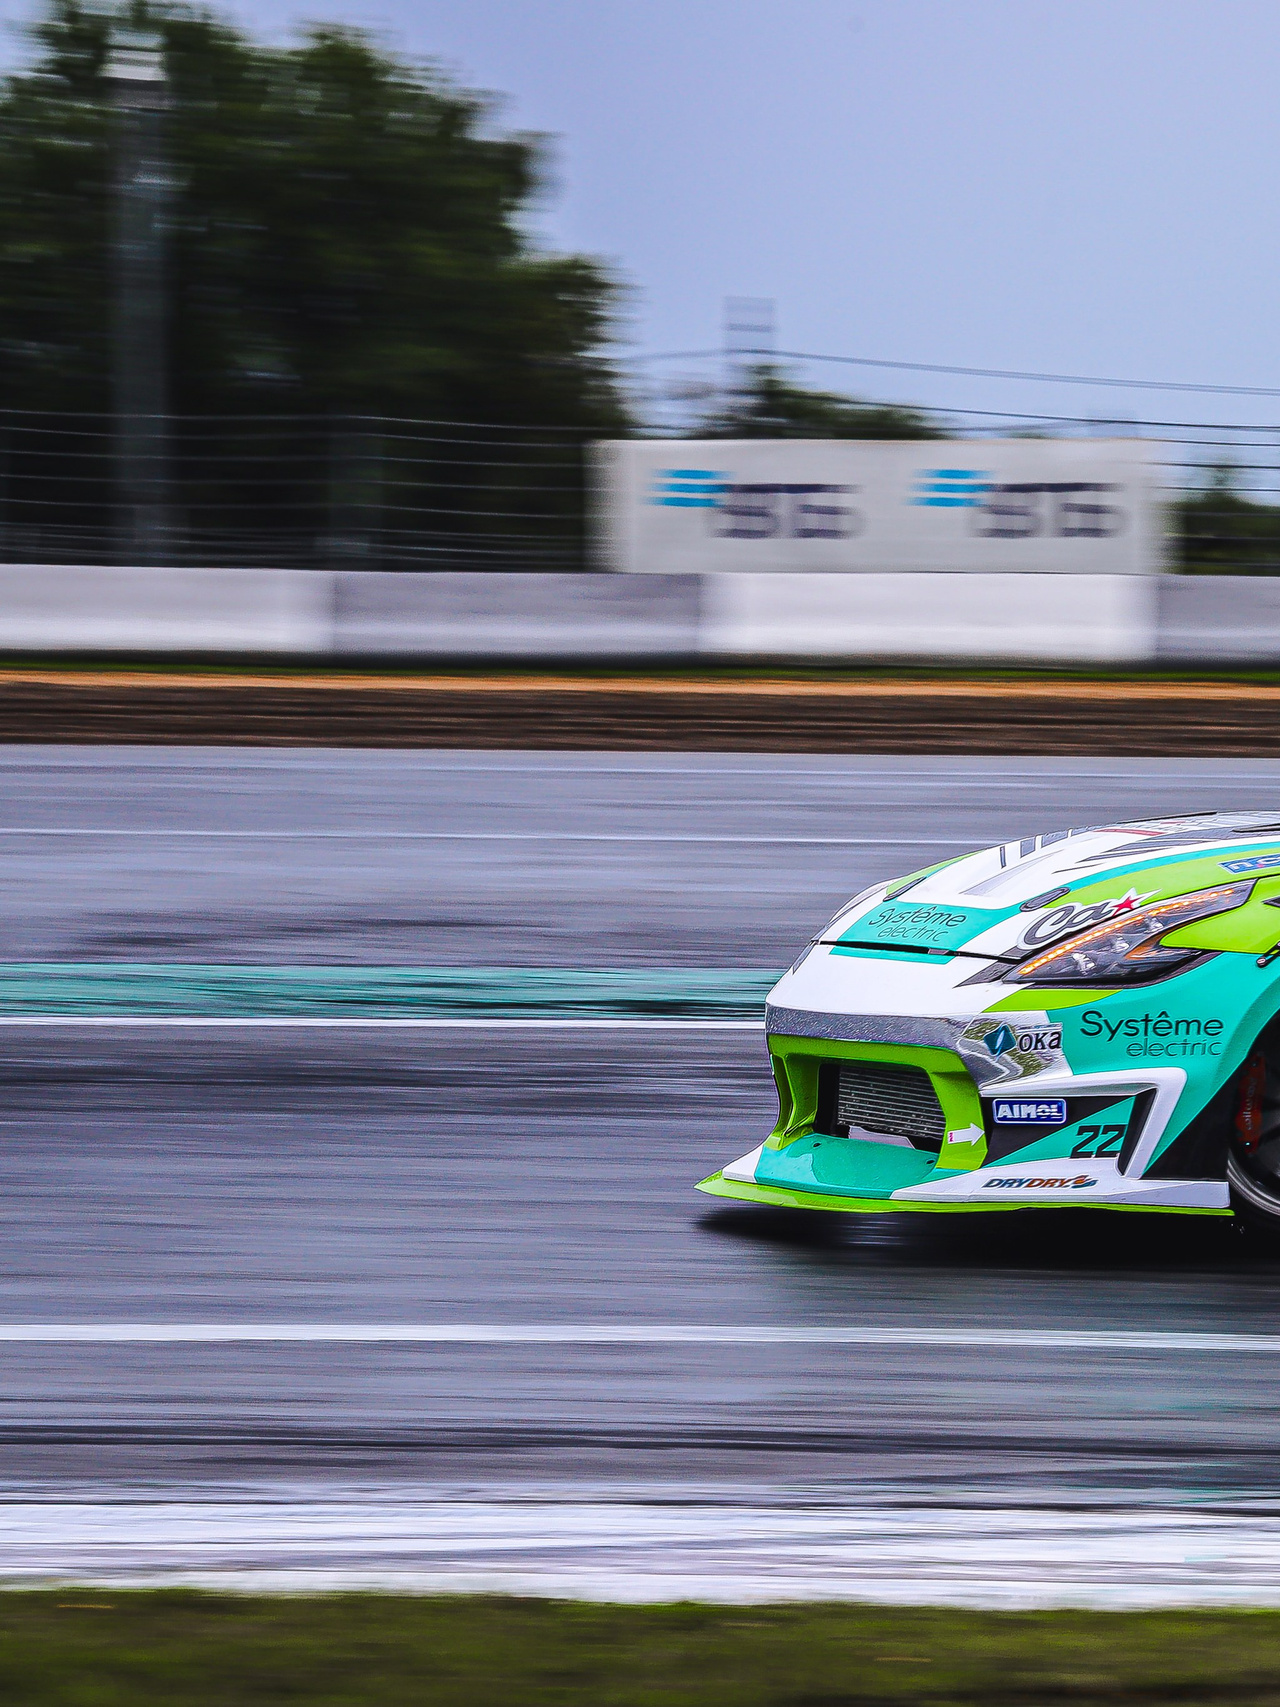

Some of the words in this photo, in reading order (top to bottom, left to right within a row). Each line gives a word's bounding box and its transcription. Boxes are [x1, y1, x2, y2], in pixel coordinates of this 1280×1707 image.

[877, 926, 948, 942] electric
[1126, 1040, 1223, 1057] electric
[998, 1104, 1061, 1119] AIMOL
[1069, 1125, 1126, 1159] 22
